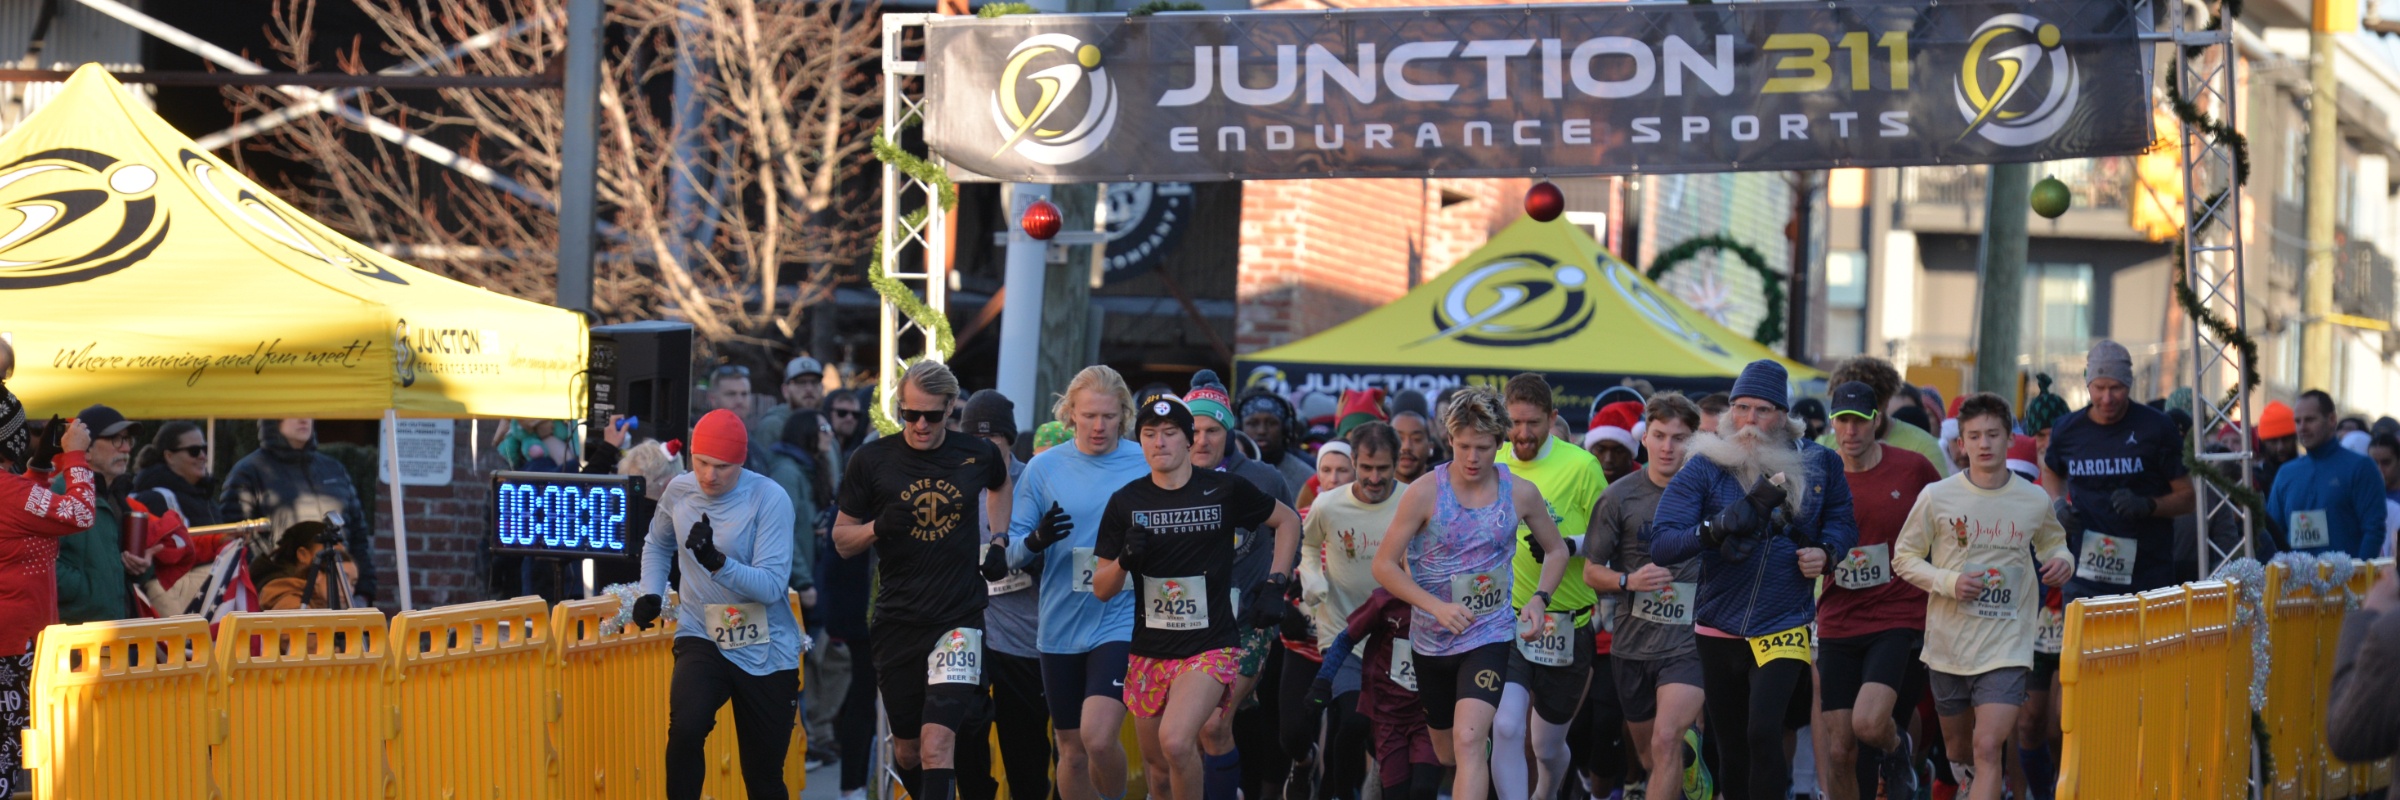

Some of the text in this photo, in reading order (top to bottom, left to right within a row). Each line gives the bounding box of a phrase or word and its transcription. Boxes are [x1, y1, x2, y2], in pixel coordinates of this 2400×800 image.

[1157, 31, 1910, 107] JUNCTION 311
[1170, 110, 1910, 153] ENDURANCE SPORTS
[417, 328, 480, 354] JUNCTION
[53, 338, 372, 387] Where running and fun meet!
[1296, 373, 1461, 394] JUNCTION
[2069, 457, 2144, 476] CAROLINA
[901, 478, 962, 501] GATE CITY
[499, 483, 626, 550] 00:00:02
[910, 513, 961, 541] HLETICS
[1152, 508, 1219, 525] GRIZZLIES
[2087, 552, 2125, 572] 2025
[1841, 565, 1881, 583] 2159
[1462, 588, 1502, 610] 2302
[1977, 587, 2012, 604] 208
[1153, 598, 1197, 615] 2425
[1642, 598, 1685, 619] 2206
[1979, 609, 1998, 617] BEER
[715, 623, 759, 643] 2173
[1758, 632, 1806, 654] 3422
[936, 650, 976, 668] 2039
[1534, 655, 1554, 663] BEER
